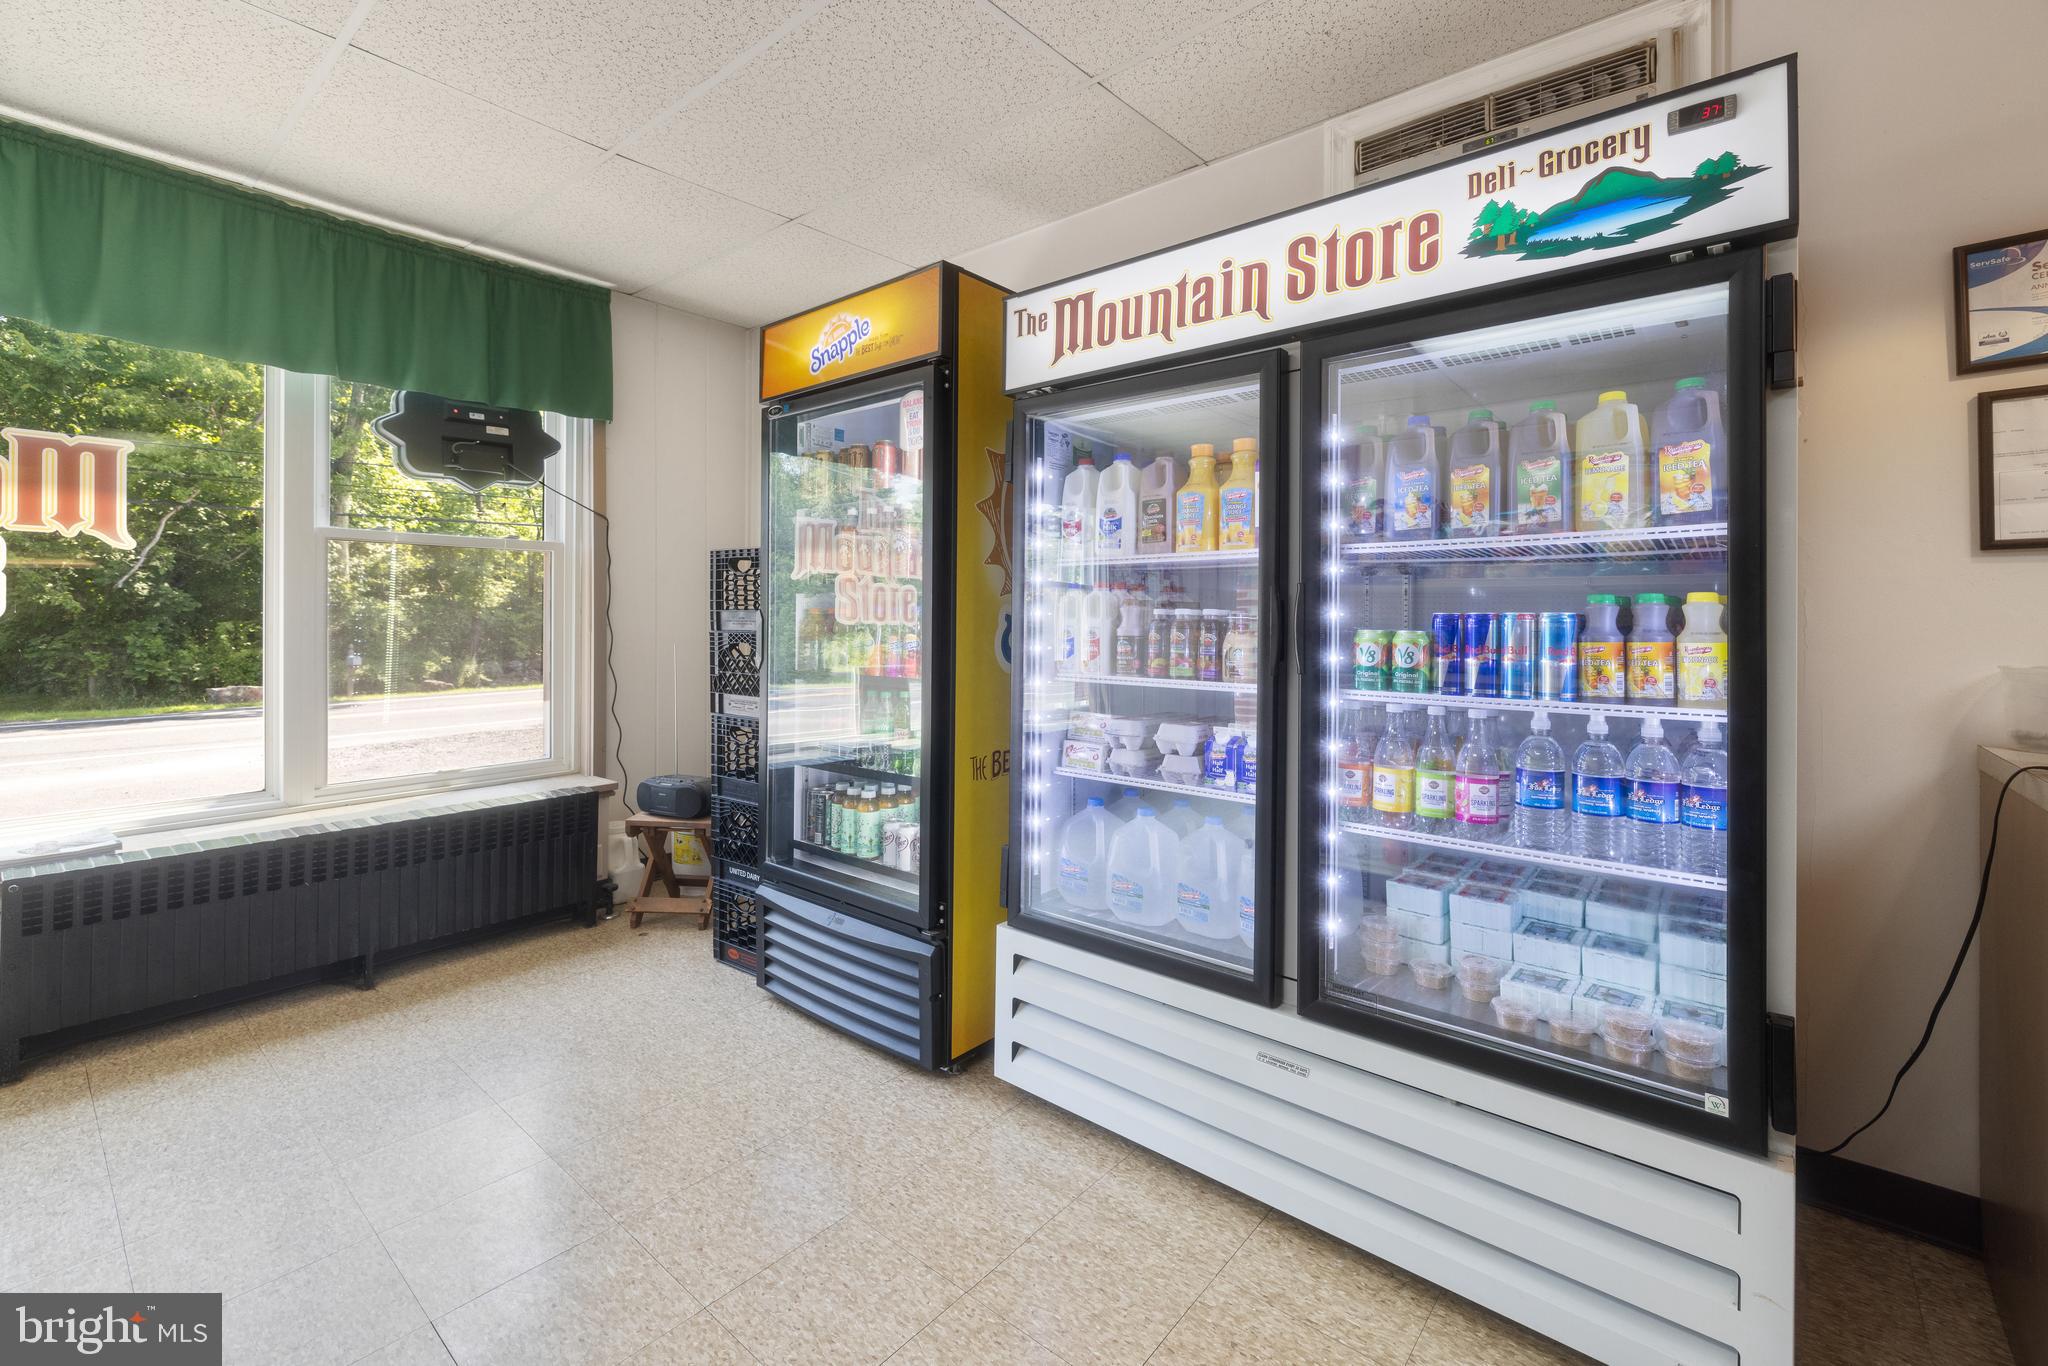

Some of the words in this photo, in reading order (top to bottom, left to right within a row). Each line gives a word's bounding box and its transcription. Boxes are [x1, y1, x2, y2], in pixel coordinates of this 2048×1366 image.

[1467, 161, 1516, 200] Deli
[1538, 123, 1651, 178] Grocery
[1969, 256, 2011, 269] ServSafe
[1014, 307, 1048, 338] The
[1051, 259, 1272, 367] Mountain
[1286, 211, 1441, 303] Store
[810, 318, 870, 373] Snapple
[1359, 644, 1377, 663] V8
[1397, 646, 1415, 665] V8
[1394, 672, 1419, 680] Original
[969, 754, 988, 781] THE
[1696, 801, 1721, 812] Ledge
[729, 867, 747, 878] UNITED
[746, 871, 760, 882] DAIRY
